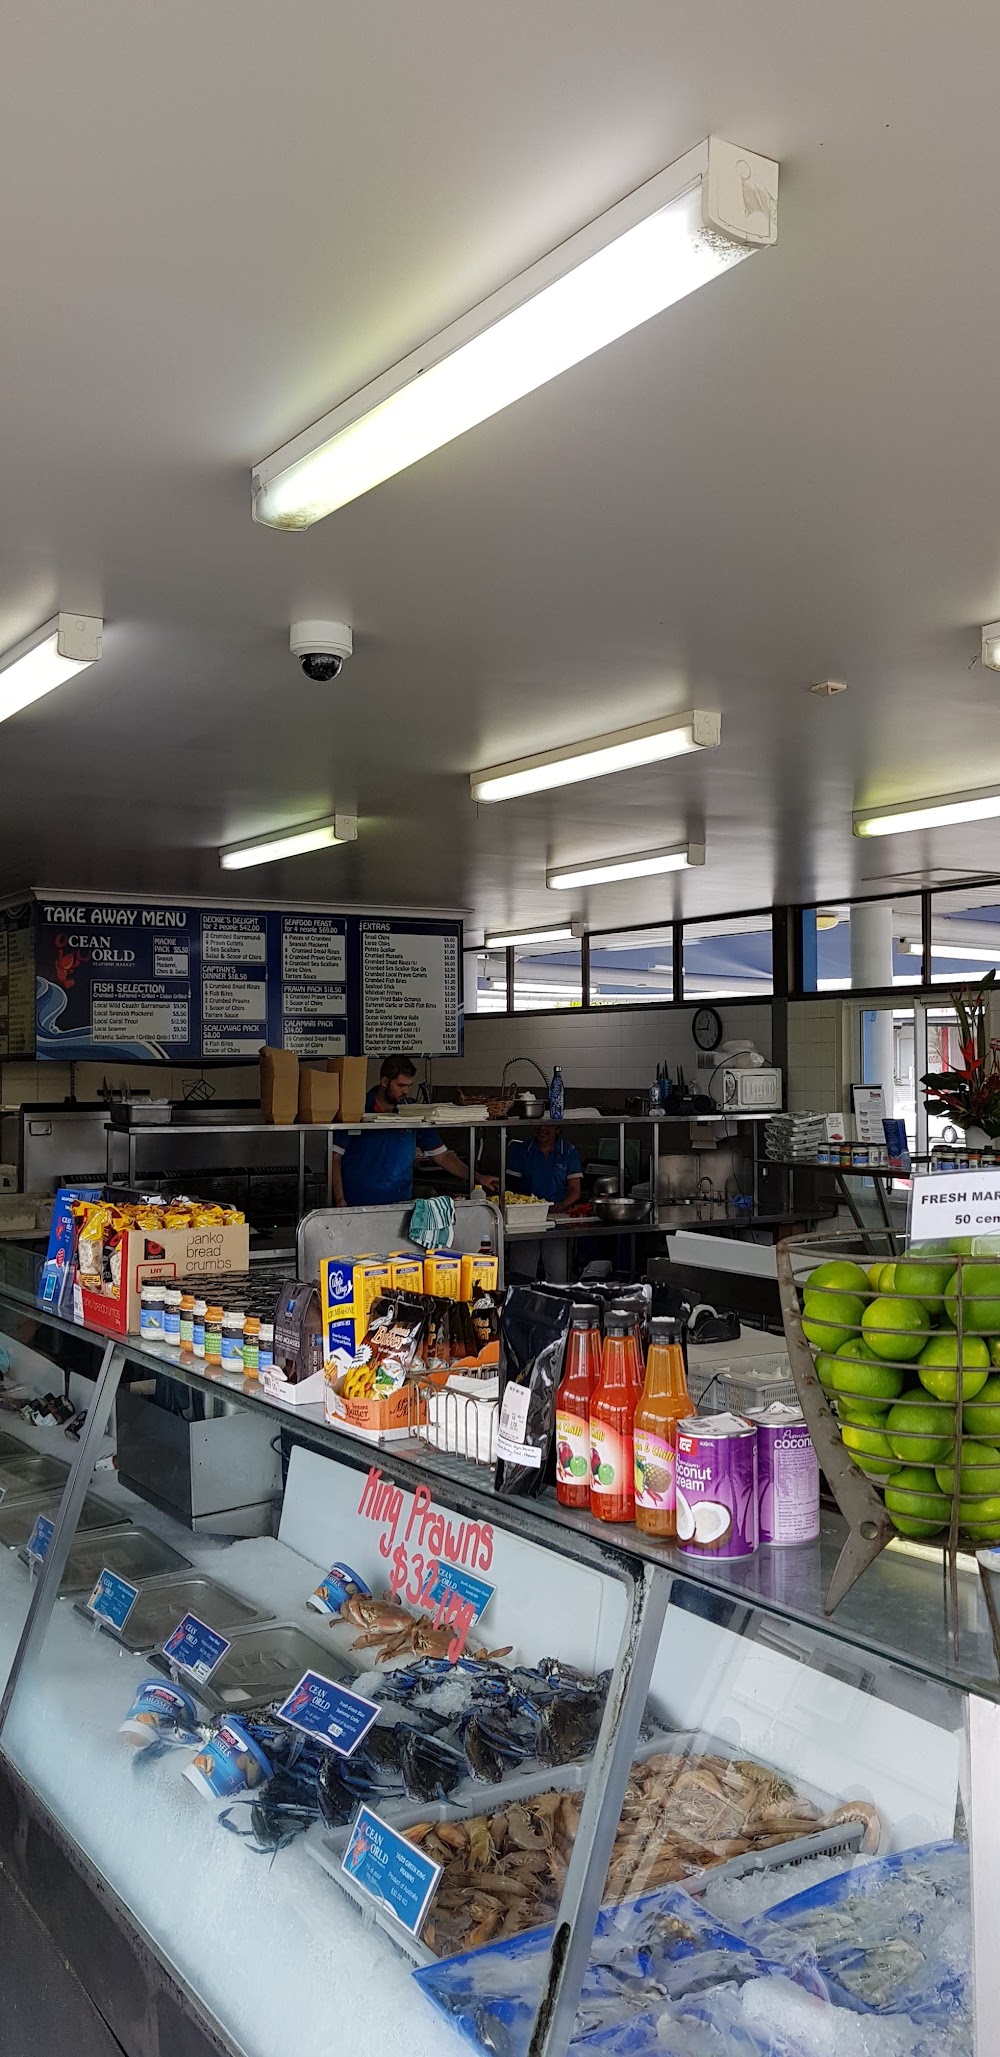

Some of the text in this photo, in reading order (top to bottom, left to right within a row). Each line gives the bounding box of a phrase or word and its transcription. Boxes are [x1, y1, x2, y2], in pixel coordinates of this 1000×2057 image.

[43, 907, 187, 927] TAKE AWAY MENU
[202, 915, 259, 925] DECKIE'S DELIGHT
[284, 918, 312, 926] SEAFOOD
[239, 924, 260, 932] $42.00
[362, 923, 391, 931] EXTRAS
[154, 938, 177, 946] MACKIE
[154, 945, 170, 953] PACK
[202, 965, 236, 974] CAPTAIN'S
[227, 973, 248, 981] $18.50
[93, 983, 165, 994] FISH SELECTION
[283, 985, 306, 993] PRAWN
[284, 1020, 316, 1028] CALAMARI
[203, 1031, 221, 1039] $8.00
[921, 1192, 967, 1205] FRESH
[955, 1214, 971, 1225] 50
[186, 1245, 222, 1259] bread
[185, 1258, 232, 1272] crumbs
[372, 1326, 404, 1349] Batter
[350, 1402, 369, 1411] Instant
[563, 1422, 583, 1438] Chilli
[652, 1445, 676, 1464] Chilli
[358, 1466, 494, 1572] King Prawns
[145, 1695, 175, 1714] MUSSELS
[400, 1866, 415, 1883] PRAWNS
[405, 1859, 418, 1873] GREEN
[416, 1869, 426, 1881] KING
[388, 1871, 401, 1885] Product
[404, 1884, 418, 1901] Australia
